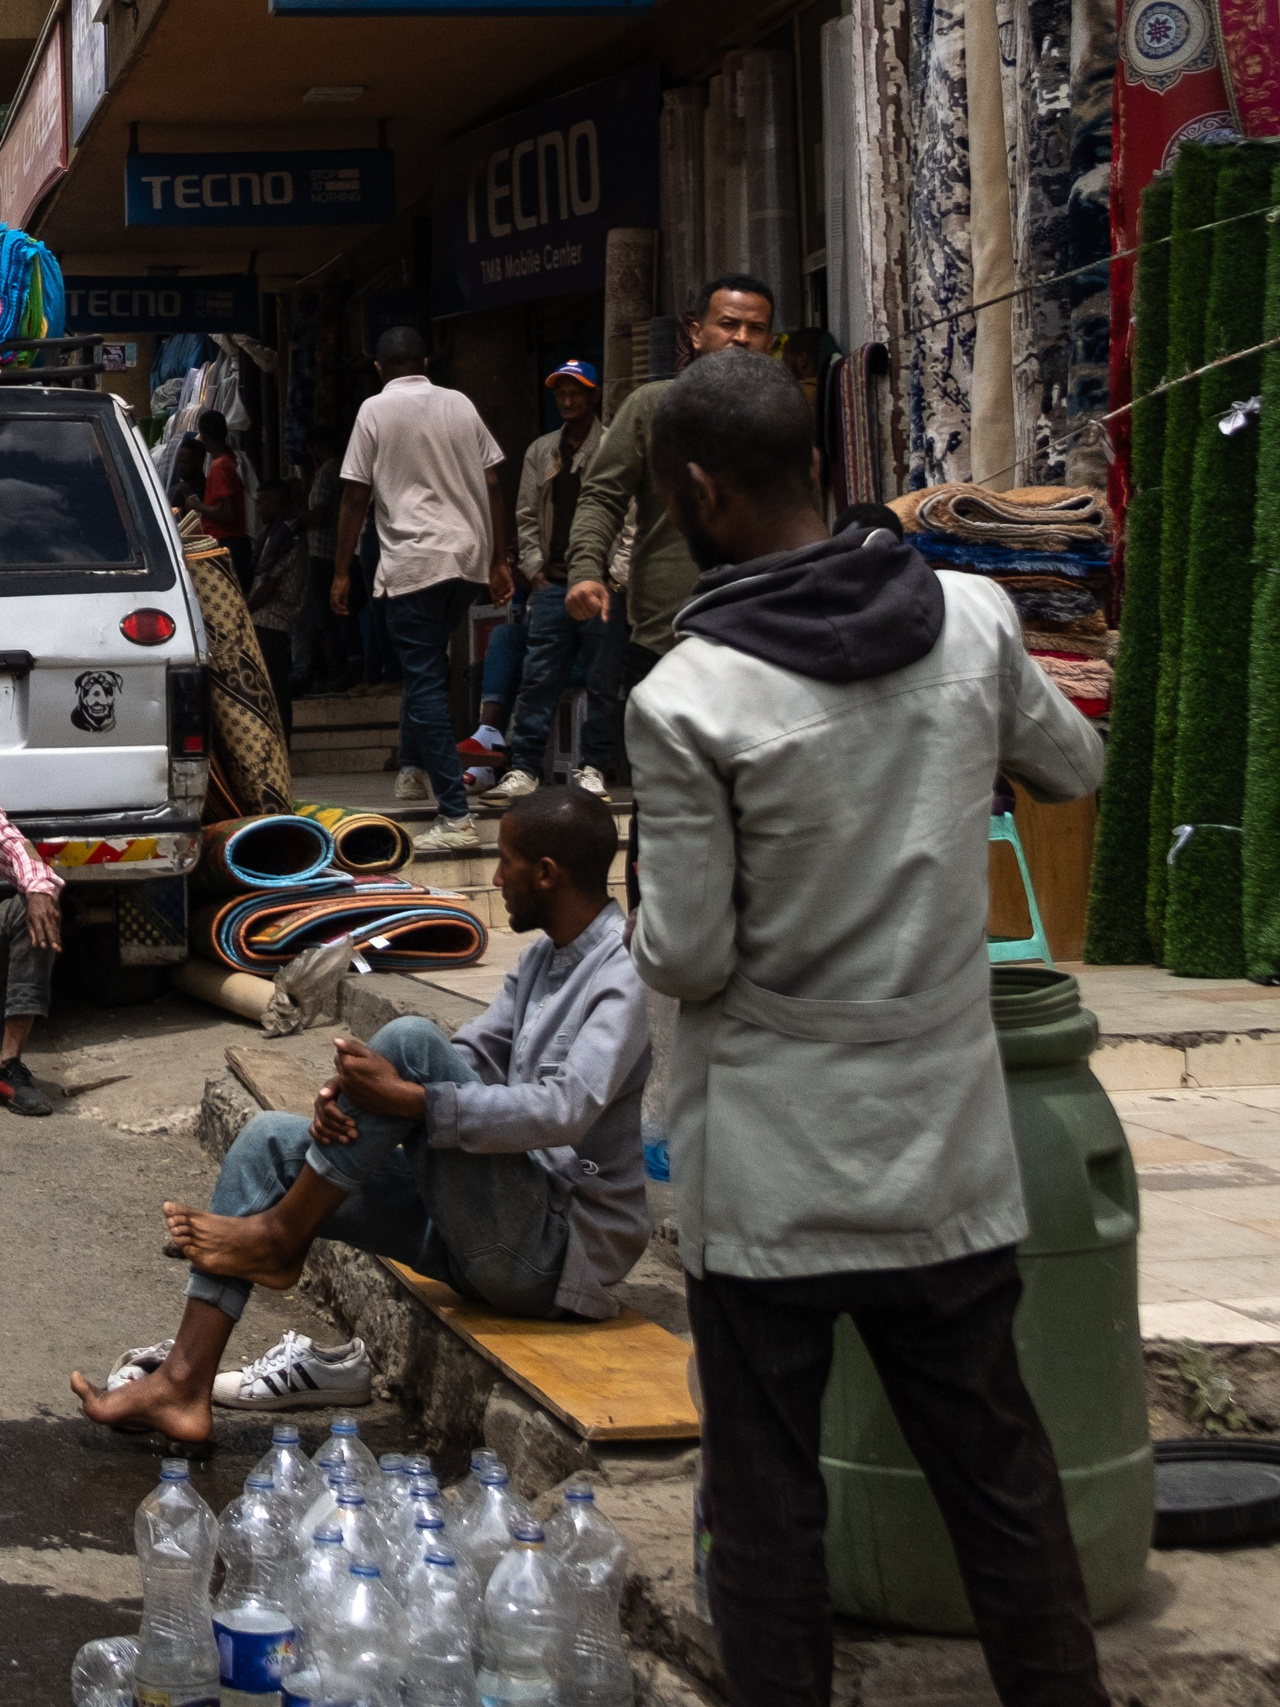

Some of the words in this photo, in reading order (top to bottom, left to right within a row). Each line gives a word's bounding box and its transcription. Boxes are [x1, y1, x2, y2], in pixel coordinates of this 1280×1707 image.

[141, 170, 294, 209] TECNO
[311, 192, 361, 203] NOTHING
[466, 119, 600, 244] TECNO
[505, 247, 541, 280] Mobile
[543, 240, 583, 271] Center
[65, 290, 182, 317] TECNO
